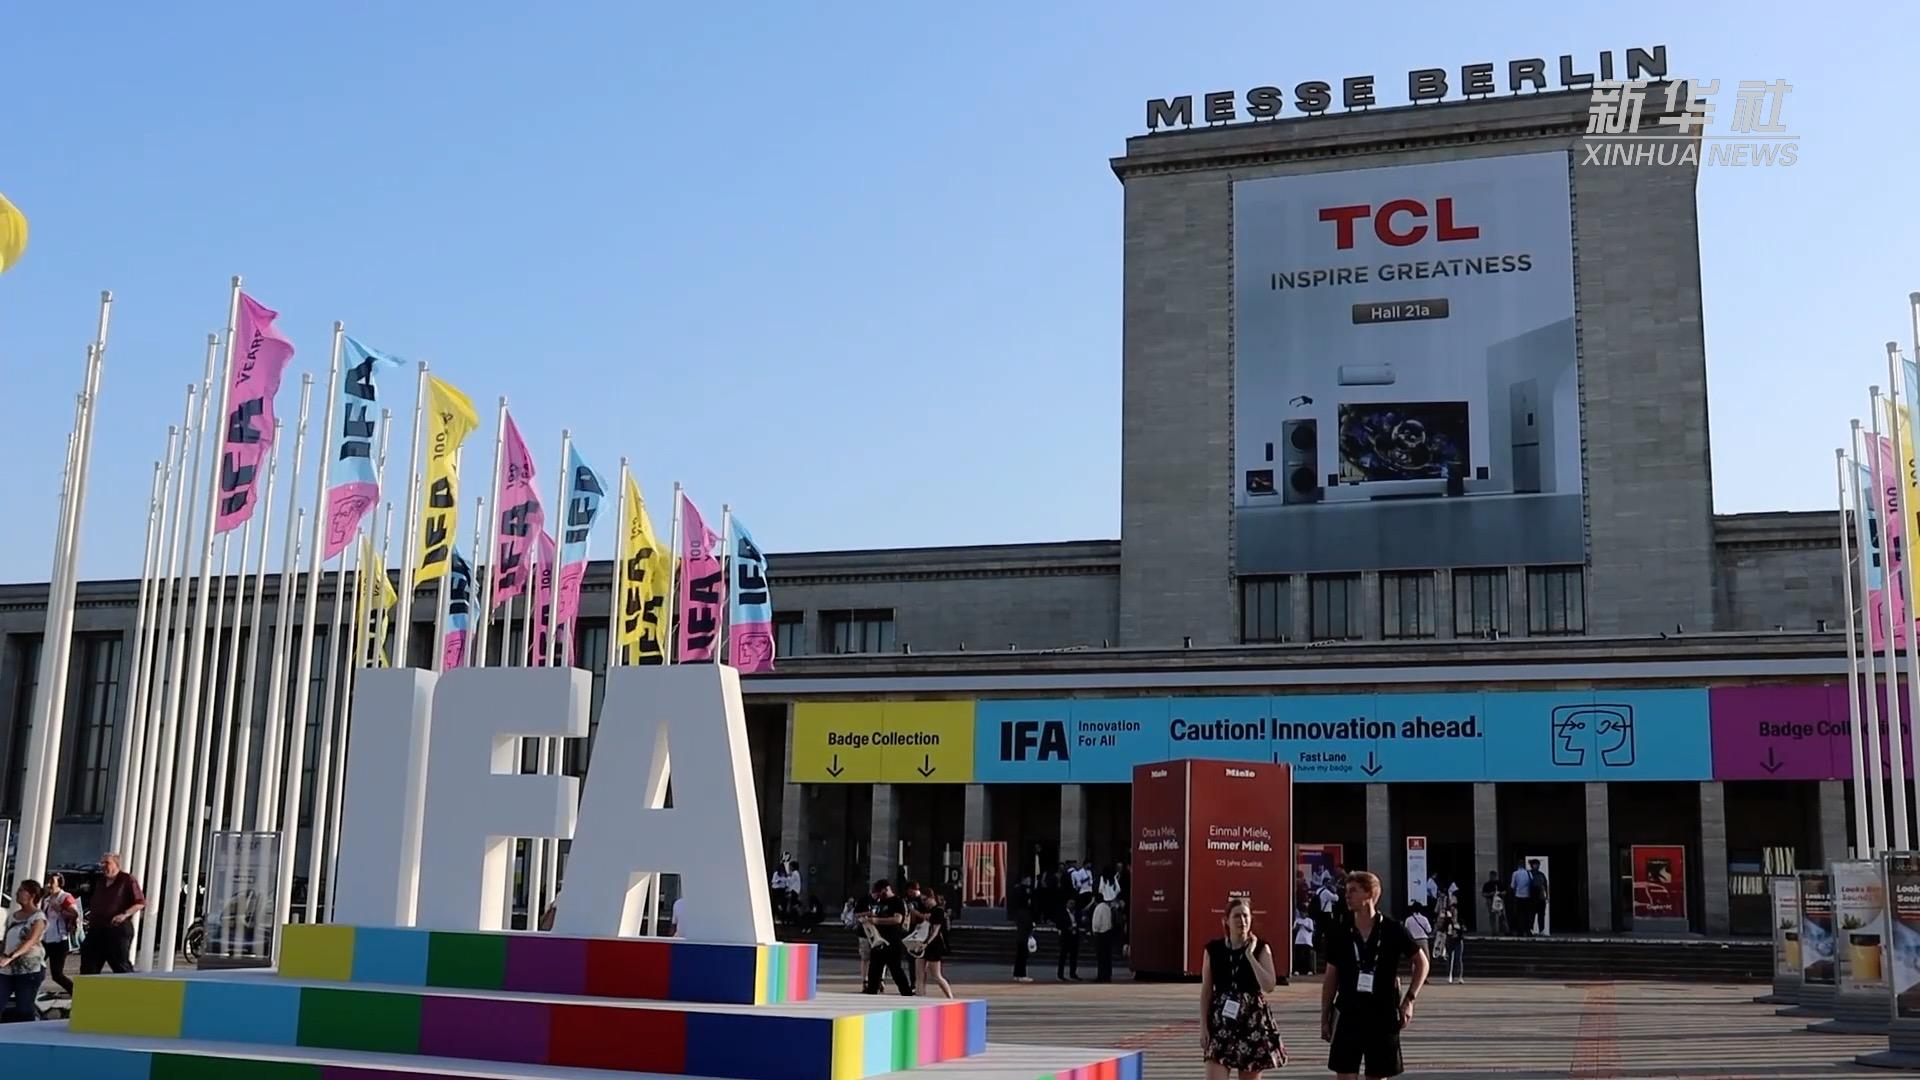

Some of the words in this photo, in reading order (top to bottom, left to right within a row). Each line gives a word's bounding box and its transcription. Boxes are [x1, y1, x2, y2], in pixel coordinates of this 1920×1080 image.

[1147, 75, 1376, 128] MESSE
[1409, 45, 1667, 100] BERLIN
[1319, 197, 1480, 250] TCL
[1271, 266, 1368, 290] INSPIRE
[1378, 254, 1532, 282] GREATNESS
[1371, 305, 1400, 320] Hall
[1405, 304, 1430, 318] 21a
[340, 356, 376, 461] IFA
[221, 397, 264, 516] IFA
[424, 476, 455, 569] IFA
[565, 465, 604, 545] IFA
[499, 500, 540, 590] IFA
[738, 536, 769, 605] IFA
[687, 572, 722, 651] IFA
[828, 732, 869, 750] Badge
[872, 731, 940, 747] Collection
[1000, 721, 1070, 761] IFA
[1078, 719, 1140, 732] Innovation
[1078, 735, 1097, 747] For
[1100, 734, 1115, 747] All
[1170, 718, 1266, 741] Caution!
[1272, 717, 1395, 740] Innovation
[1401, 715, 1483, 738] ahead.
[1759, 721, 1813, 740] Badge
[1225, 768, 1256, 778] Miele
[1300, 752, 1320, 762] Fast
[1323, 752, 1347, 762] Lane
[1317, 765, 1327, 773] my
[1329, 763, 1353, 773] badge
[334, 665, 776, 944] IFA
[1209, 825, 1240, 837] Einmal
[1242, 826, 1271, 840] Miele,
[1241, 839, 1272, 851] Miele.
